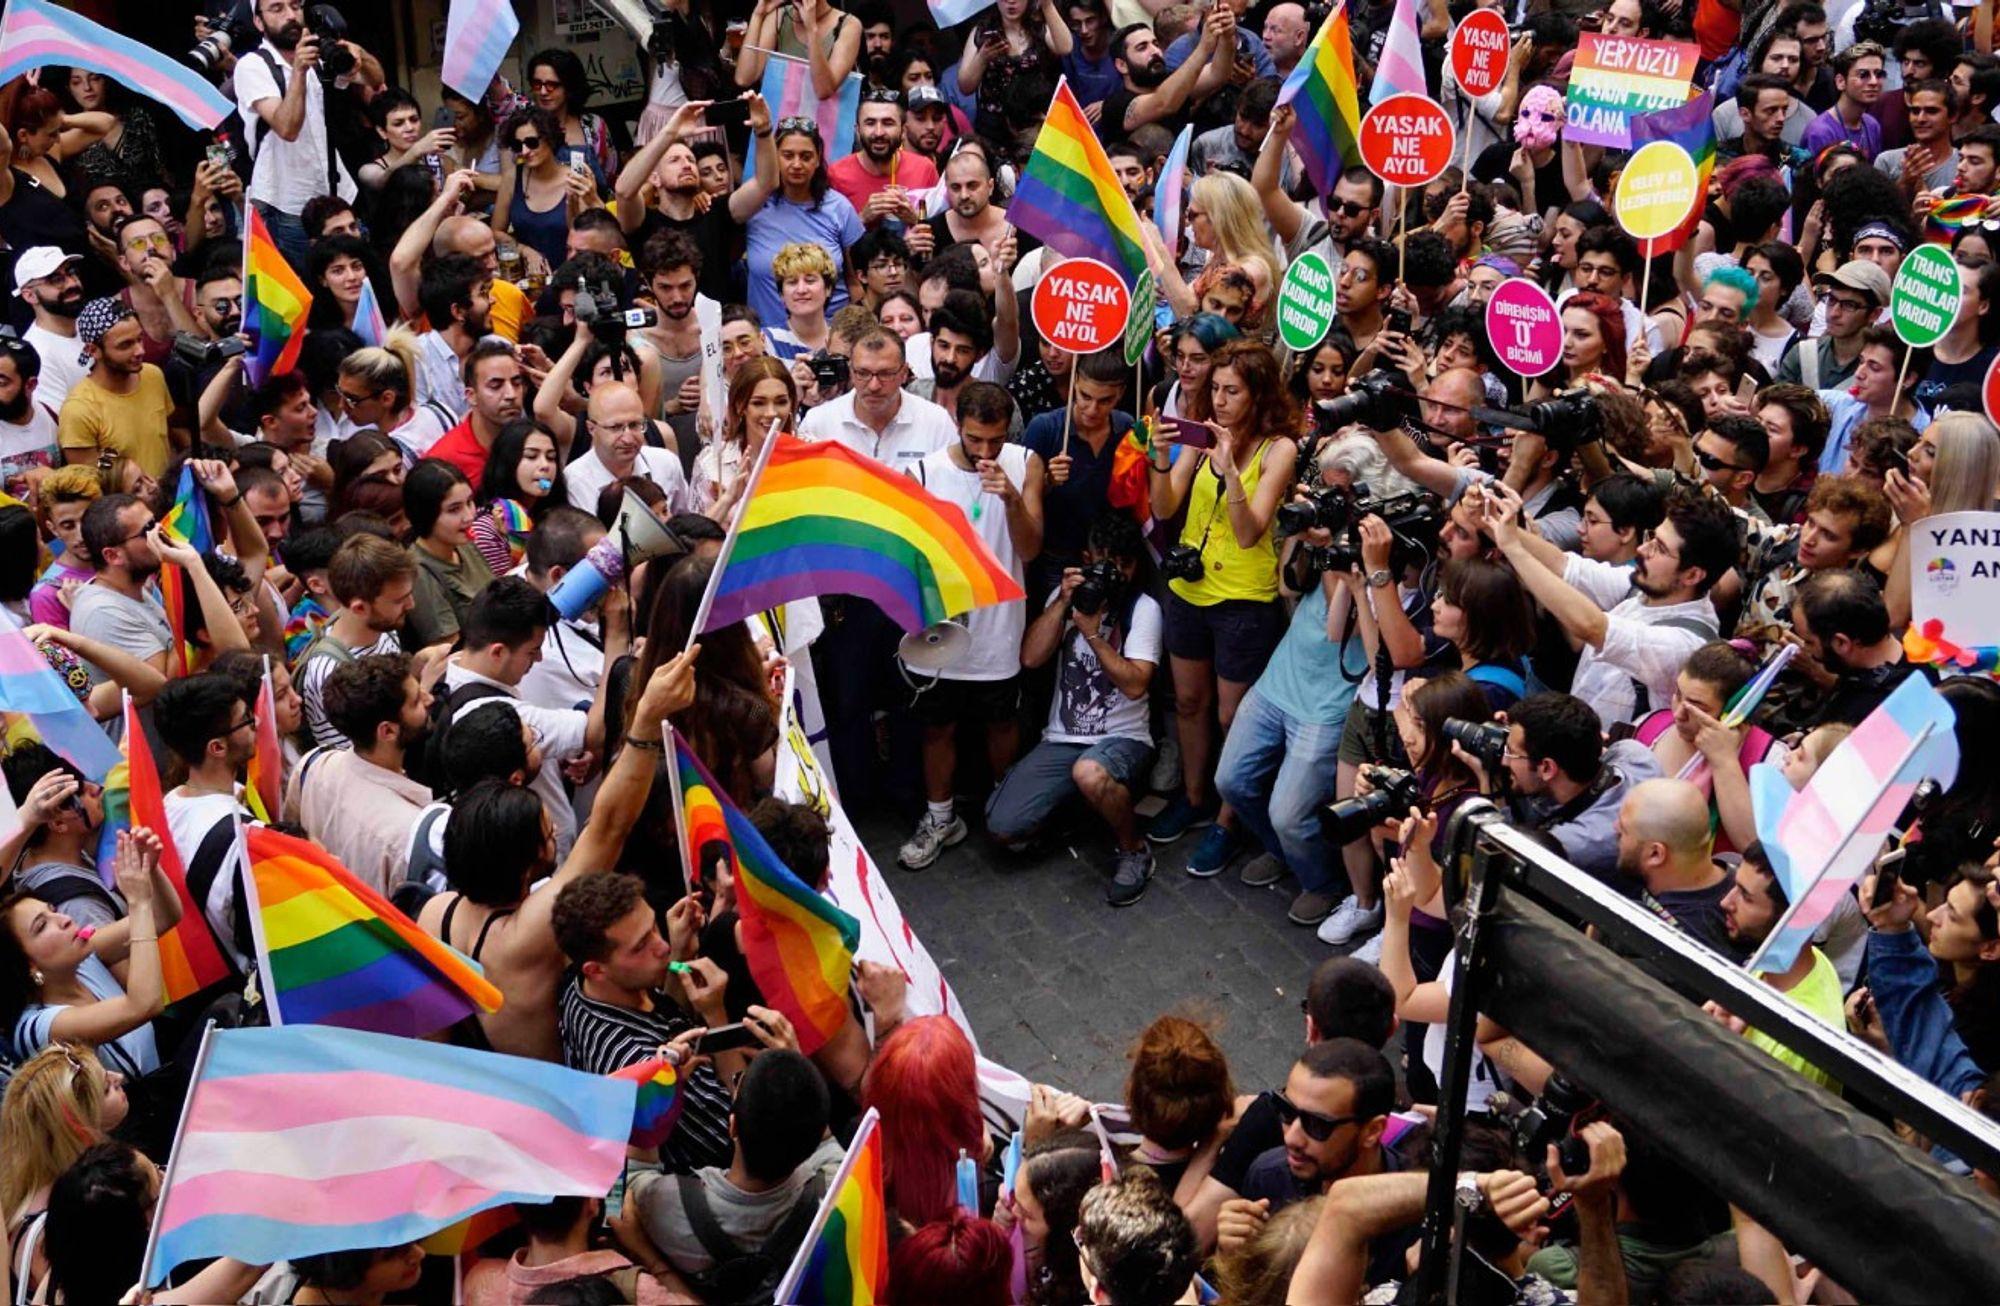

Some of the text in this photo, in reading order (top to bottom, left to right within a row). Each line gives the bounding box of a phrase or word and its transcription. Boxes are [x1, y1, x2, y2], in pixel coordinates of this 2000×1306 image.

[1462, 27, 1506, 51] YASAK
[1472, 49, 1490, 69] NE
[1593, 39, 1679, 77] YERYÜZÜ
[1464, 68, 1491, 88] AYOL
[1371, 115, 1443, 136] YASAK
[1568, 103, 1625, 136] OLANA
[1393, 136, 1420, 156] NE
[1382, 156, 1429, 175] AYOL
[1295, 260, 1329, 293] TRANS
[1912, 253, 1955, 285] TRANS
[1048, 276, 1120, 306] YASAK
[1283, 278, 1332, 320] KADINLAR
[1895, 271, 1959, 314] KADINLAR
[1065, 301, 1095, 323] NE
[1283, 303, 1318, 338] VARDIR
[1897, 298, 1942, 333] VARDIR
[1053, 320, 1099, 344] AYOL
